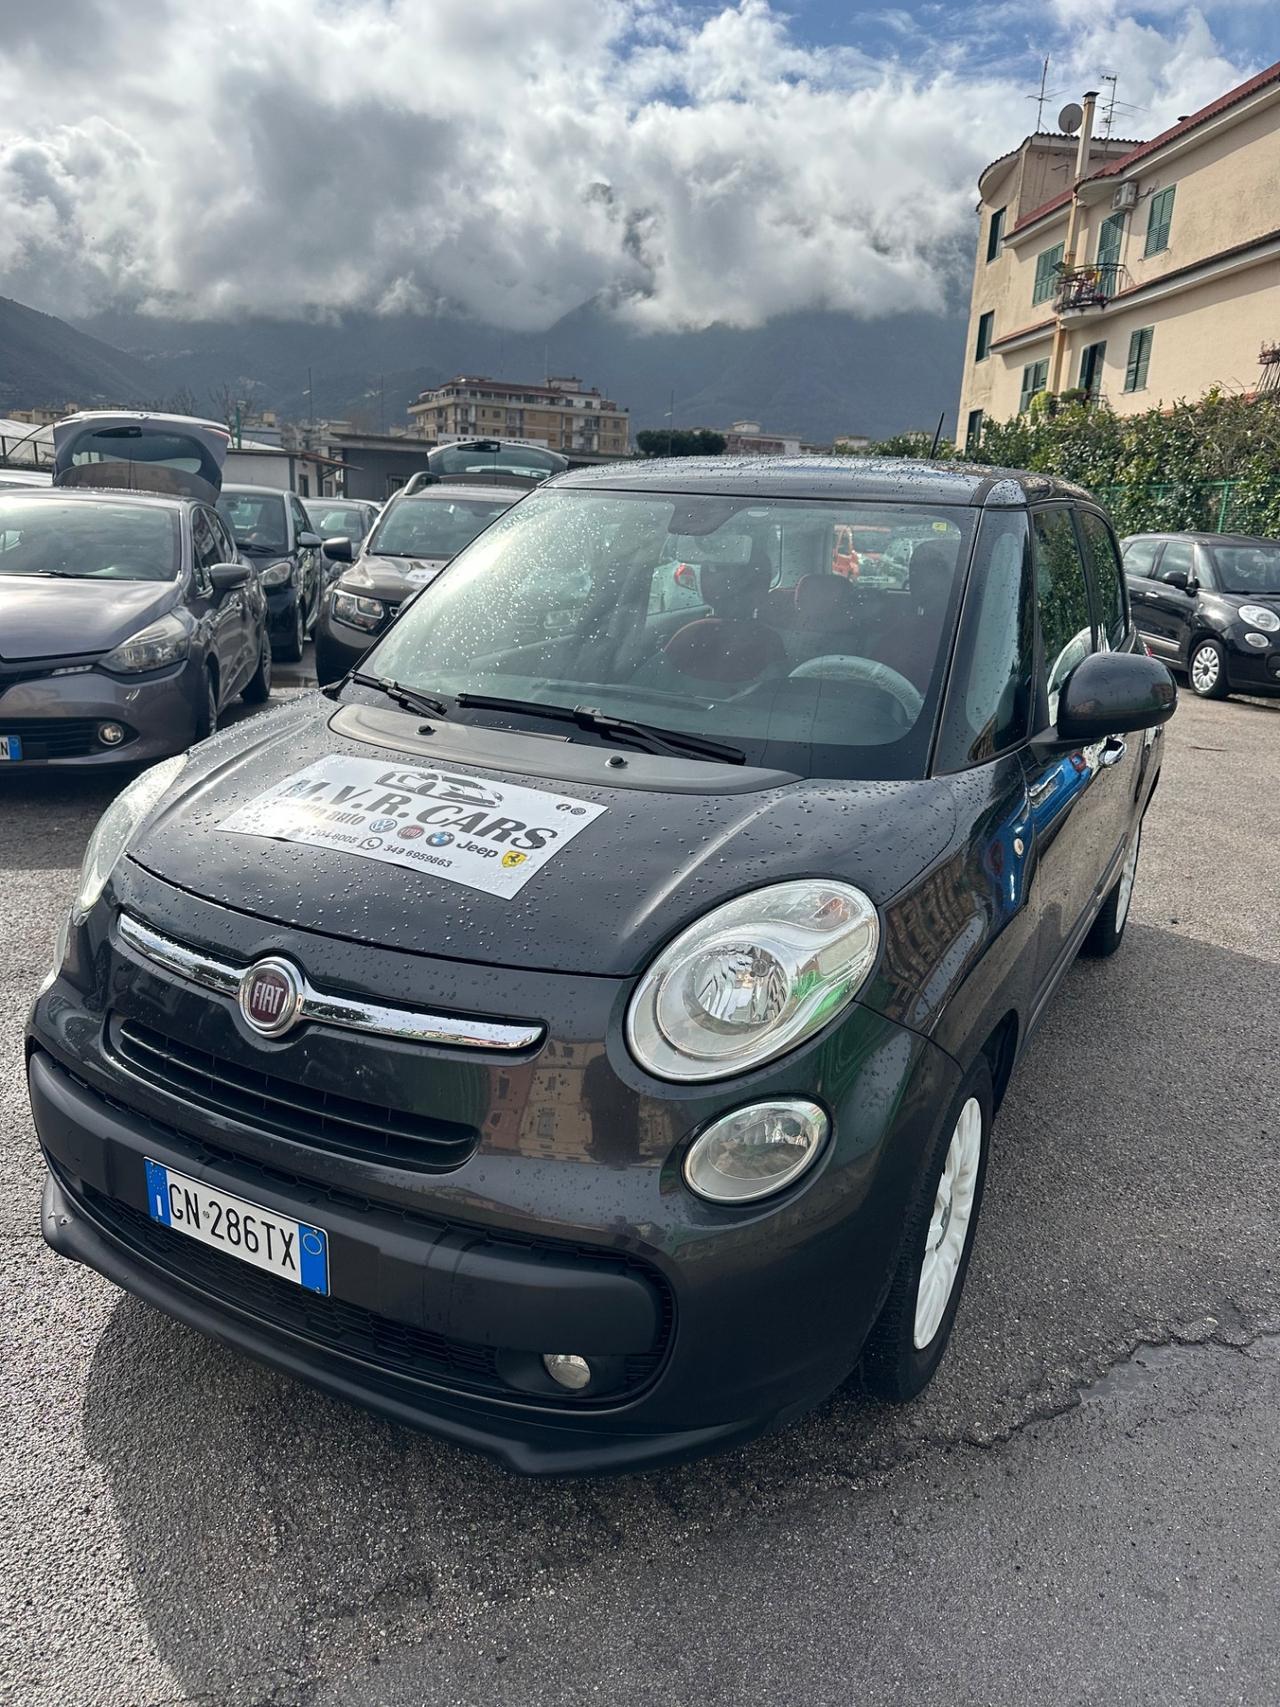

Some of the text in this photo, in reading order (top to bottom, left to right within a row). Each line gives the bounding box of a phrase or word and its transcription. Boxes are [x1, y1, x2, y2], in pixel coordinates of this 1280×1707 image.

[383, 844, 406, 855] 349
[456, 840, 499, 858] Jeep
[252, 981, 284, 1015] FIAT
